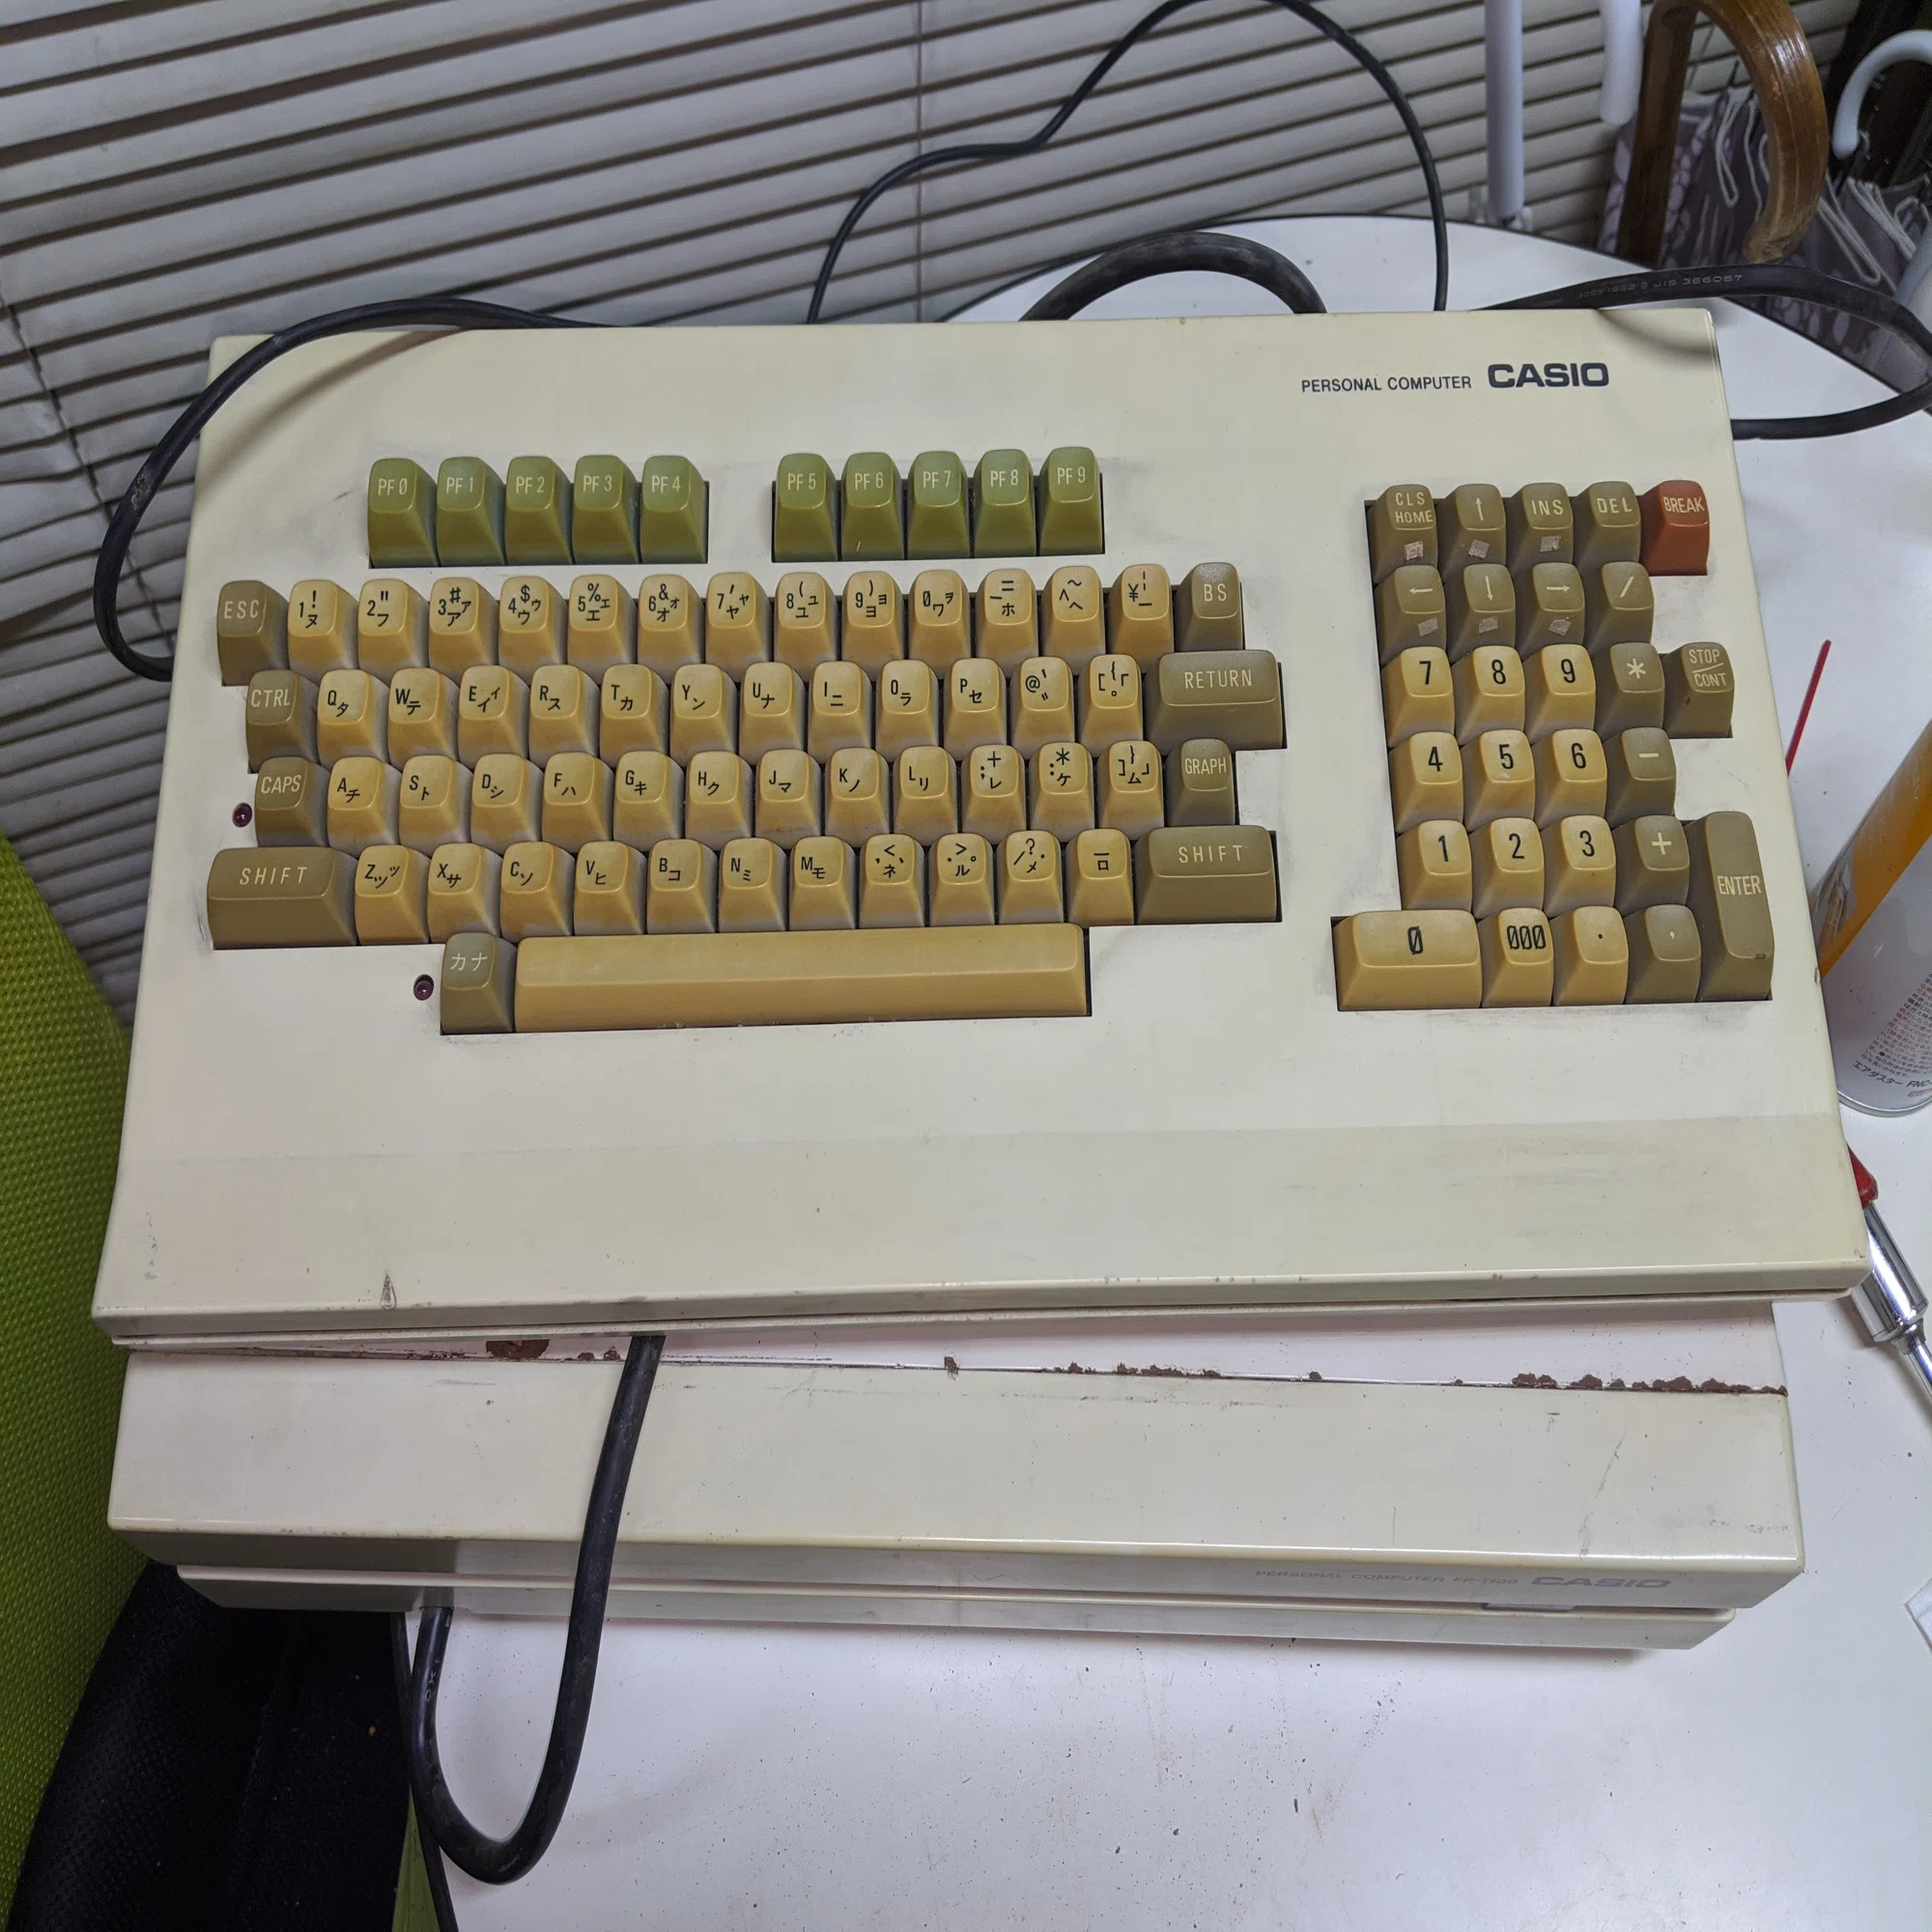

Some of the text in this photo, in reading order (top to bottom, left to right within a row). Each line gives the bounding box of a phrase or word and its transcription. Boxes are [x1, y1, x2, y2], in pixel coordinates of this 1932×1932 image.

[1302, 363, 1608, 392] PERSONAL COMPUTER CASIO
[1396, 492, 1424, 505] CLS
[1597, 497, 1632, 513] DEL
[1663, 497, 1704, 513] BREAK
[1532, 499, 1563, 515] INS
[1395, 510, 1433, 523] HOME
[1128, 583, 1138, 602] ¥
[1204, 583, 1226, 601] BS
[438, 599, 446, 615] 3
[508, 598, 517, 613] 4
[578, 596, 585, 611] 5
[649, 596, 656, 611] 6
[718, 593, 724, 609] 7
[786, 593, 794, 609] 8
[856, 592, 863, 609] 9
[224, 600, 259, 618] ESC
[299, 602, 303, 617] 1
[367, 600, 376, 616] 2
[657, 608, 669, 622] オ
[726, 606, 739, 619] ヤ
[796, 608, 809, 618] ユ
[867, 606, 876, 617] ヨ
[933, 604, 944, 616] ワ
[1002, 603, 1014, 616] ホ
[305, 614, 318, 628] ヌ
[378, 613, 388, 627] フ
[447, 612, 461, 627] ア
[518, 610, 529, 625] ウ
[586, 611, 600, 621] エ
[1689, 649, 1719, 664] STOP
[1419, 661, 1431, 685] 7
[1492, 660, 1506, 684] 8
[1561, 659, 1576, 683] 9
[960, 678, 967, 693] P
[1184, 669, 1251, 689] RETURN
[1694, 673, 1725, 687] CONT
[469, 686, 477, 701] E
[540, 686, 549, 700] R
[611, 685, 620, 700] T
[682, 685, 690, 700] Y
[753, 683, 760, 697] U
[825, 682, 827, 696] I
[891, 680, 898, 695] O
[251, 689, 289, 707] CTRL
[327, 690, 336, 705] Q
[396, 689, 411, 704] W
[620, 696, 633, 711] カ
[761, 695, 775, 709] ナ
[900, 693, 911, 705] ラ
[969, 690, 981, 703] セ
[336, 702, 349, 717] タ
[407, 701, 421, 715] テ
[478, 697, 491, 713] イ
[548, 698, 560, 710] ス
[693, 698, 705, 710] ン
[1429, 747, 1442, 772] 4
[1499, 744, 1514, 769] 5
[1572, 743, 1586, 769] 6
[1185, 757, 1226, 774] GRAPH
[554, 773, 562, 787] F
[626, 770, 635, 785] G
[698, 772, 706, 786] H
[769, 771, 776, 784] J
[839, 768, 847, 782] K
[909, 766, 916, 781] L
[1057, 773, 1070, 786] ケ
[1128, 773, 1141, 783] ム
[261, 775, 301, 793] CAPS
[337, 778, 347, 792] A
[410, 776, 418, 790] S
[482, 774, 491, 788] D
[634, 781, 646, 795] キ
[779, 782, 791, 793] マ
[849, 780, 860, 792] ノ
[920, 778, 928, 791] リ
[990, 778, 1002, 789] レ
[346, 789, 360, 803] チ
[421, 786, 429, 801] ト
[491, 786, 503, 799] シ
[708, 782, 719, 796] ク
[1438, 836, 1448, 862] 1
[1509, 834, 1524, 859] 2
[1580, 831, 1595, 857] 3
[1179, 845, 1242, 863] SHIFT
[510, 862, 520, 876] C
[586, 861, 595, 875] V
[660, 858, 668, 872] B
[731, 858, 740, 872] N
[801, 857, 812, 870] M
[955, 865, 970, 876] ル
[1027, 862, 1037, 873] メ
[240, 867, 307, 885] SHIFT
[365, 865, 375, 879] Z
[438, 864, 448, 878] X
[668, 870, 680, 881] コ
[743, 869, 751, 881] ミ
[810, 866, 825, 879] モ
[883, 865, 895, 878] ネ
[374, 876, 387, 889] ツ
[446, 874, 461, 888] サ
[521, 873, 533, 886] ソ
[595, 872, 606, 885] ヒ
[1718, 875, 1761, 895] ENTER
[450, 952, 487, 971] カナ
[1853, 1061, 1902, 1085] エアダスター
[1531, 1577, 1671, 1588] CASIO
